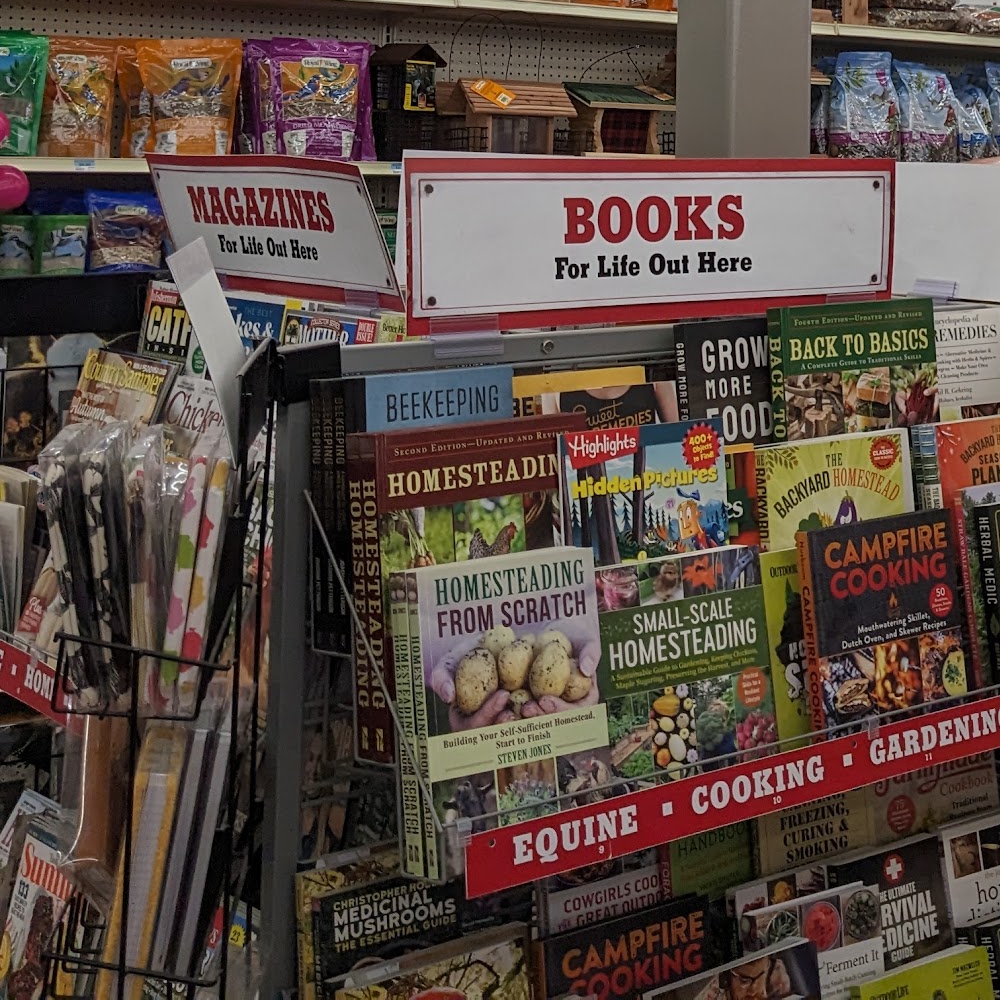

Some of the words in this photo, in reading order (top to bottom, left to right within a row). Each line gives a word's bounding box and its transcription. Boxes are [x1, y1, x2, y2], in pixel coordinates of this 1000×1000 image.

[186, 185, 335, 233] MAGAZINES
[563, 195, 745, 244] BOOKS
[217, 234, 238, 254] For
[240, 236, 264, 258] Life
[266, 239, 287, 259] Out
[290, 240, 318, 261] Here
[555, 257, 590, 279] For
[597, 254, 640, 278] Life
[648, 253, 690, 276] Out
[698, 251, 753, 273] Here
[356, 332, 373, 343] ISSUE!
[358, 321, 375, 333] DOUBLE
[676, 342, 685, 365] GROW
[702, 336, 769, 375] GROW
[789, 338, 837, 361] BACK
[844, 334, 865, 355] TO
[869, 328, 929, 353] BASICS
[767, 338, 783, 402] BACK
[807, 360, 837, 370] COMPLETE
[839, 357, 858, 366] GUIDE
[867, 354, 903, 364] TRADITIONAL
[904, 352, 922, 361] SKILLS
[120, 360, 164, 396] Sampler
[677, 366, 688, 404] MORE
[706, 377, 752, 400] MORE
[386, 385, 499, 422] BEEKEEPING
[772, 404, 787, 439] TO
[394, 446, 428, 457] SECOND
[516, 433, 534, 443] AND
[568, 434, 637, 460] Highlights
[688, 433, 713, 445] 400+
[692, 443, 713, 454] Objects
[872, 448, 893, 457] CLASSIC
[960, 434, 997, 465] BACKYARD
[825, 453, 843, 467] THE
[571, 475, 643, 499] Hidden
[643, 467, 718, 489] Pictures
[773, 471, 831, 519] BACKYARD
[833, 468, 901, 502] HOMESTEAD
[824, 522, 948, 570] CAMPFIRE
[979, 517, 994, 562] HERBAL
[435, 559, 585, 607] HOMESTEADING
[830, 552, 948, 600] COOKING
[984, 565, 998, 606] MEDIC
[935, 587, 946, 598] 50
[437, 606, 495, 638] FROM
[502, 589, 588, 628] SCRATCH
[633, 597, 733, 635] SMALL-SCALE
[857, 617, 907, 635] Mouthwatering
[907, 612, 931, 626] Skillet,
[609, 617, 758, 671] HOMESTEADING
[841, 635, 862, 649] Dutch
[864, 632, 884, 646] Oven,
[885, 629, 898, 640] and
[899, 624, 922, 638] Skewer
[923, 619, 948, 635] Recipes
[443, 736, 478, 749] Building
[480, 732, 498, 743] Your
[499, 720, 553, 738] Self-Sufficient
[554, 712, 597, 730] Homestead,
[495, 737, 517, 750] Start
[518, 736, 526, 745] to
[527, 730, 552, 743] Finish
[497, 749, 527, 766] STEVEN
[528, 744, 553, 761] JONES
[939, 771, 994, 797] Cookbook
[513, 804, 638, 865] EQUINE
[690, 754, 825, 814] COOKING
[598, 845, 605, 854] 9
[772, 796, 782, 805] 10
[925, 753, 933, 761] 11
[780, 802, 850, 831] FREEZING,
[784, 820, 834, 847] CURING
[838, 818, 849, 833] &
[786, 837, 848, 864] SMOKING
[333, 885, 397, 912] CHRISTOPHER
[563, 882, 631, 914] COWGIRLS
[888, 881, 916, 900] ULTIMATE
[333, 889, 433, 926] MEDICINAL
[334, 898, 457, 943] MUSHROOMS
[230, 929, 241, 943] 23
[335, 940, 356, 953] THE
[359, 925, 420, 949] ESSENTIAL
[422, 914, 457, 933] GUIDE
[562, 911, 704, 979] CAMPFIRE
[825, 952, 868, 975] Ferment
[870, 949, 881, 964] It
[891, 945, 914, 963] GUIDE
